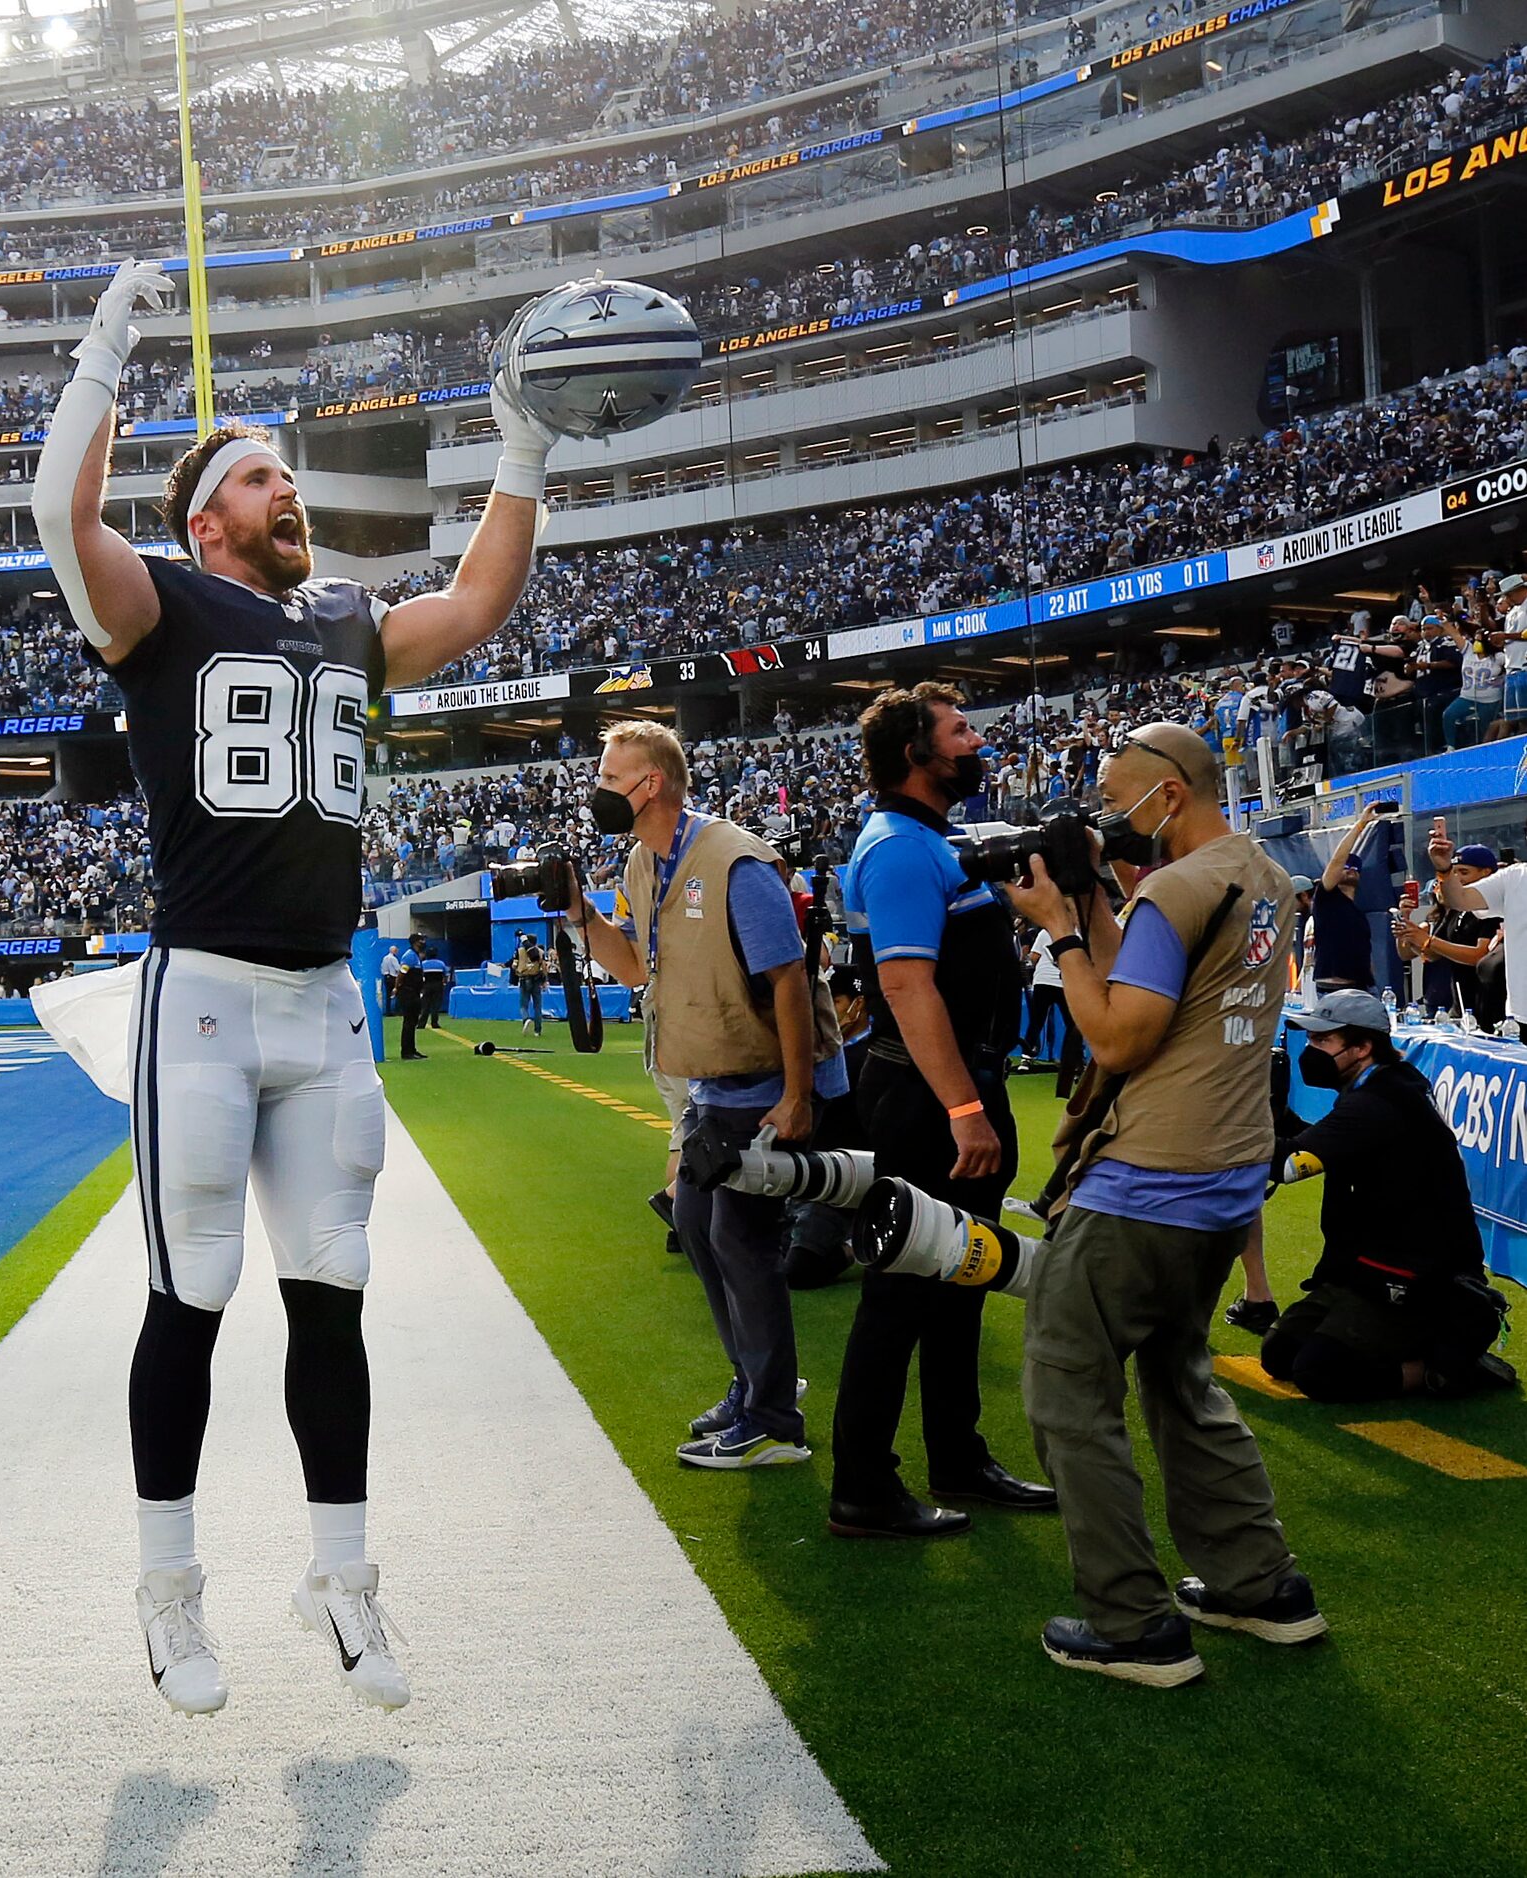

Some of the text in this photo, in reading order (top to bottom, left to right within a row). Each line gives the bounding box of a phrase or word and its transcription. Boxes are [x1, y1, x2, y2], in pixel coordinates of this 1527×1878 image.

[1112, 48, 1143, 68] LOS
[1147, 15, 1227, 56] ANGELES
[698, 130, 883, 188] LOS ANGELES CHARGERS
[1383, 157, 1453, 207] LOS
[321, 218, 493, 256] LOS ANGELES CHARGERS
[44, 265, 118, 280] CHARGERS
[719, 298, 922, 353] LOS ANGELES CHARGERS
[316, 382, 490, 418] LOS ANGELES CHARGER
[1446, 467, 1527, 510] Q4 0:00
[1282, 534, 1331, 565] AROUND
[1333, 524, 1355, 550] THE
[1357, 506, 1404, 543] LEAGUE
[1049, 595, 1065, 617] 22
[1068, 588, 1089, 613] ATT
[1110, 579, 1135, 604] 131
[1138, 571, 1163, 596] YDS
[1183, 564, 1193, 587] 0
[933, 612, 988, 638] MIN COOK
[805, 642, 821, 661] 34
[1332, 645, 1360, 672] 21
[679, 662, 696, 681] 33
[437, 690, 476, 710] AROUND
[478, 686, 499, 703] THE
[502, 681, 541, 702] LEAGUE
[194, 652, 369, 828] 86
[445, 899, 488, 910] SoFi Stadium
[1223, 1015, 1256, 1046] 104
[966, 1237, 985, 1273] WEEK
